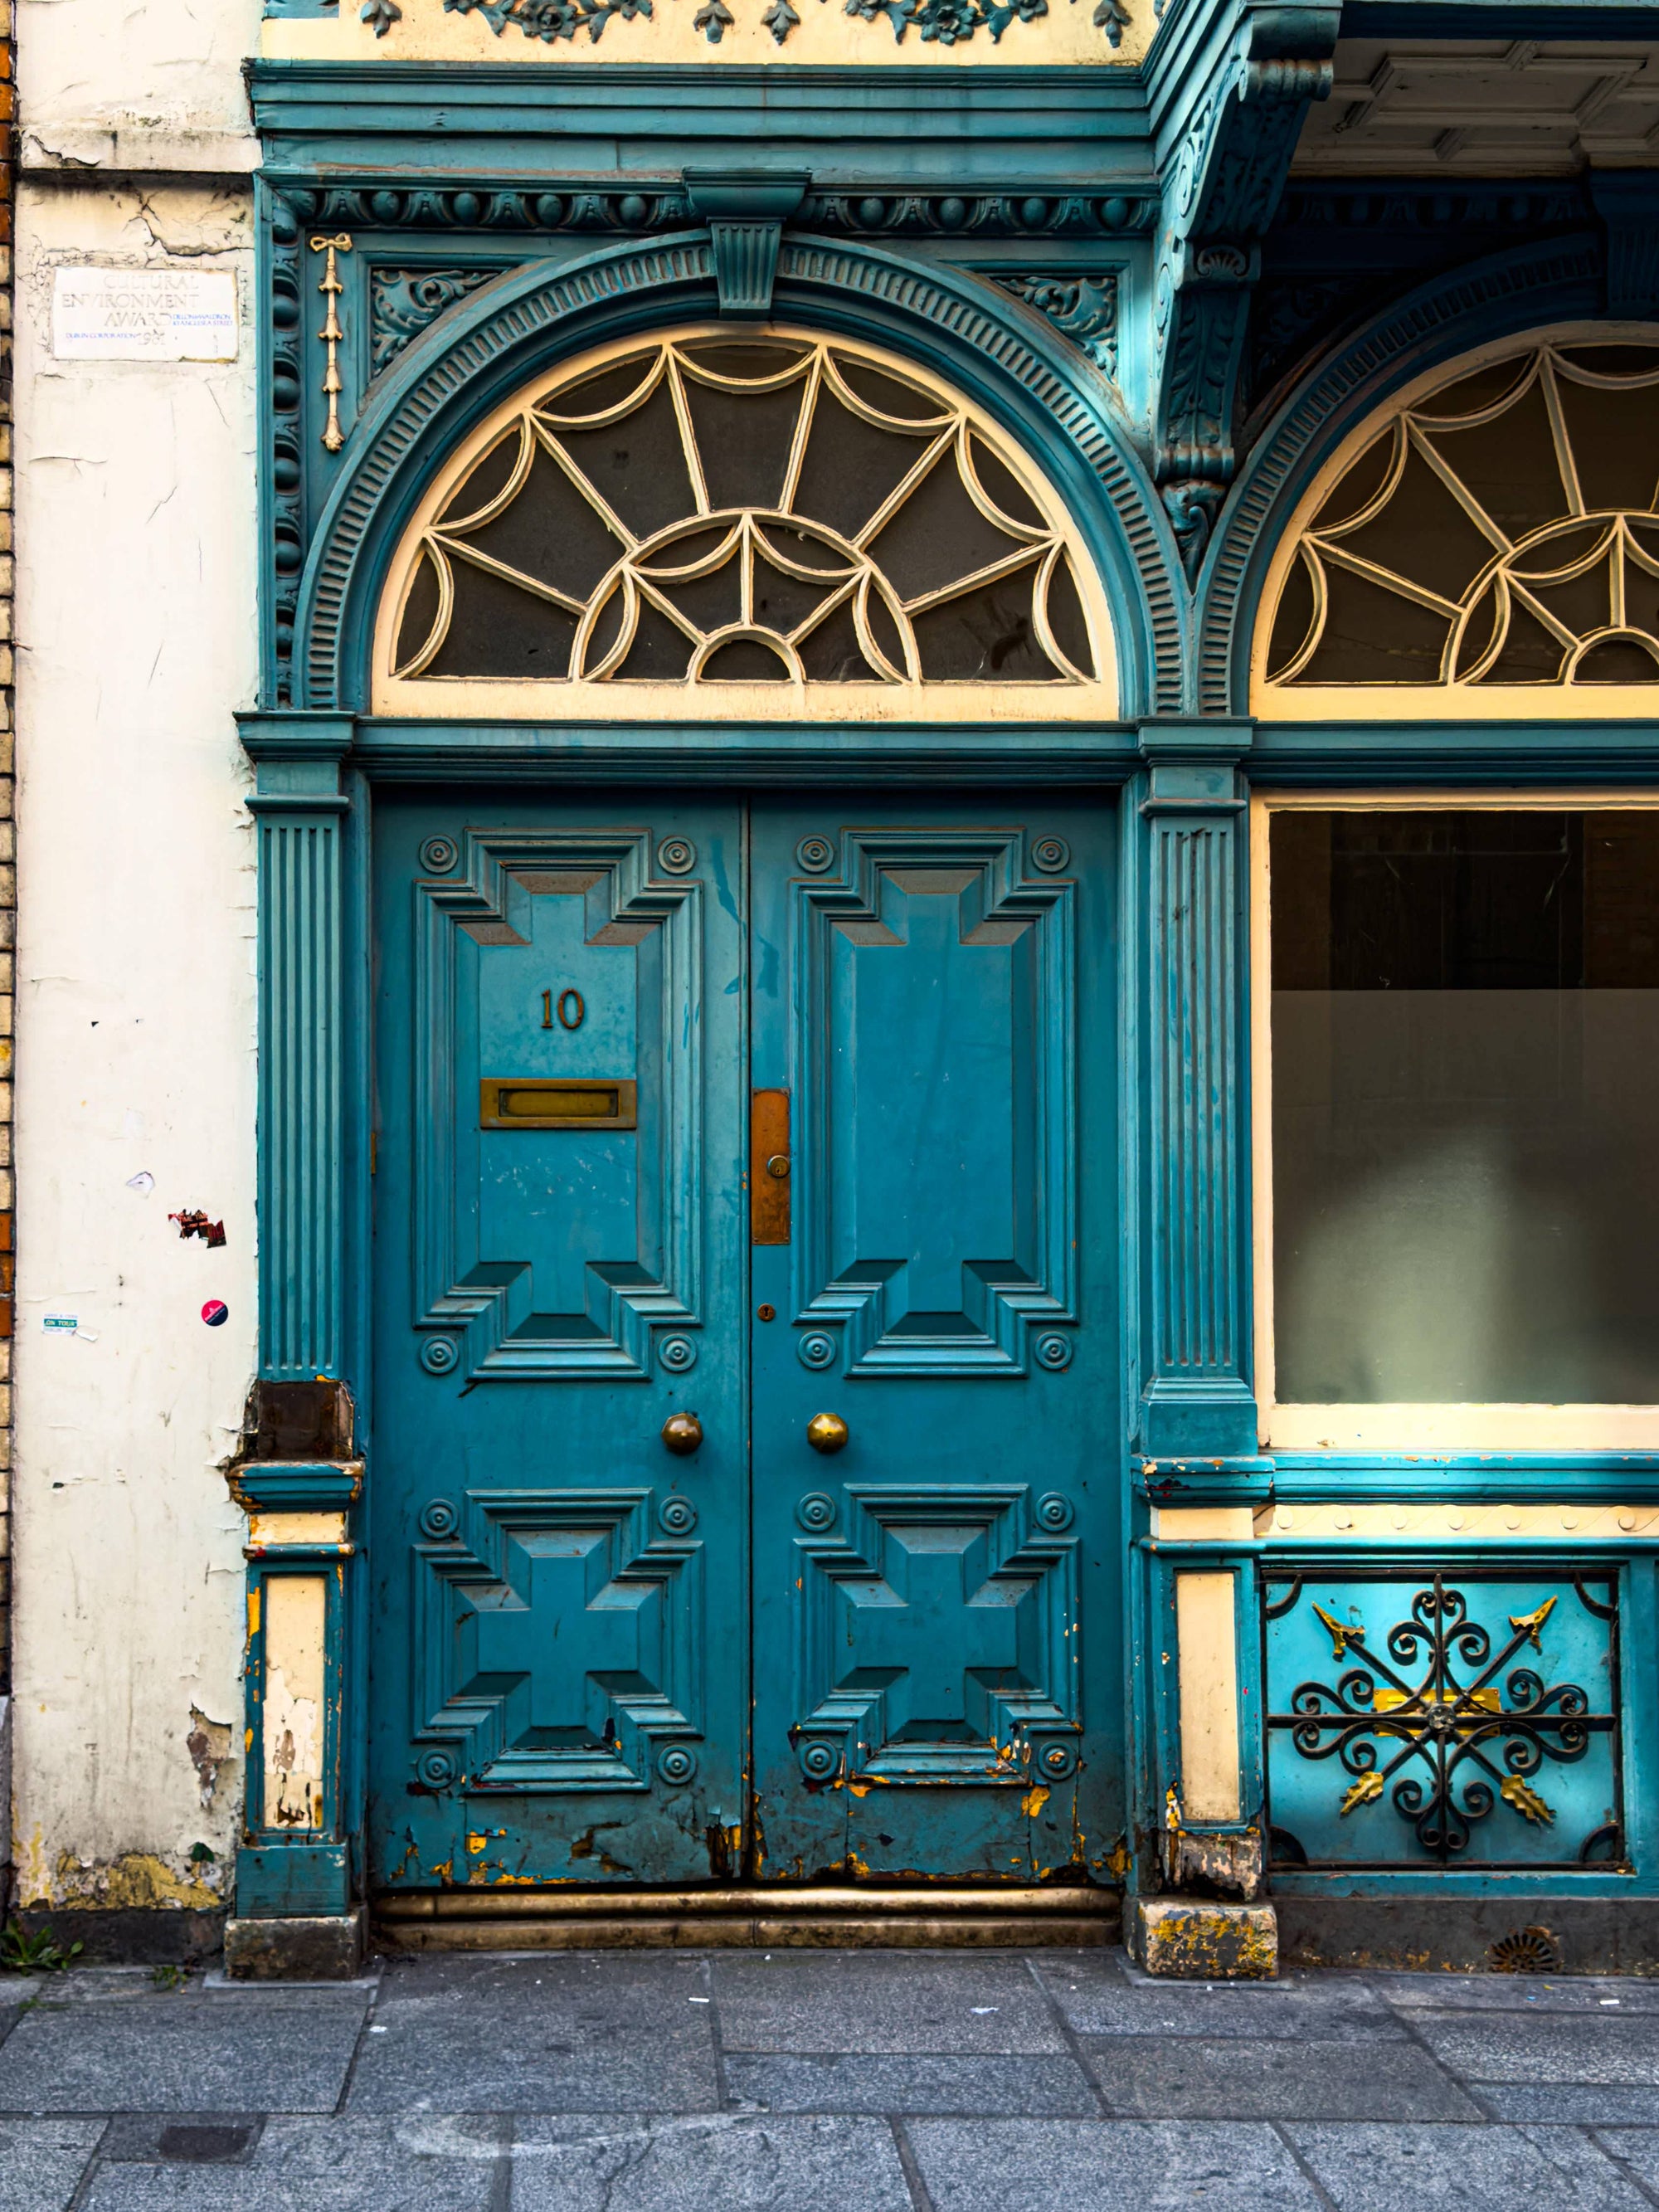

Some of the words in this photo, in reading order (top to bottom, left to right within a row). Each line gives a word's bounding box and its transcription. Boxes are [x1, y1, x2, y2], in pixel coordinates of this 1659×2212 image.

[103, 275, 199, 290] CULTURAL
[61, 294, 199, 308] ENVIRONMENT
[104, 312, 172, 327] AWARD
[541, 987, 585, 1030] 10
